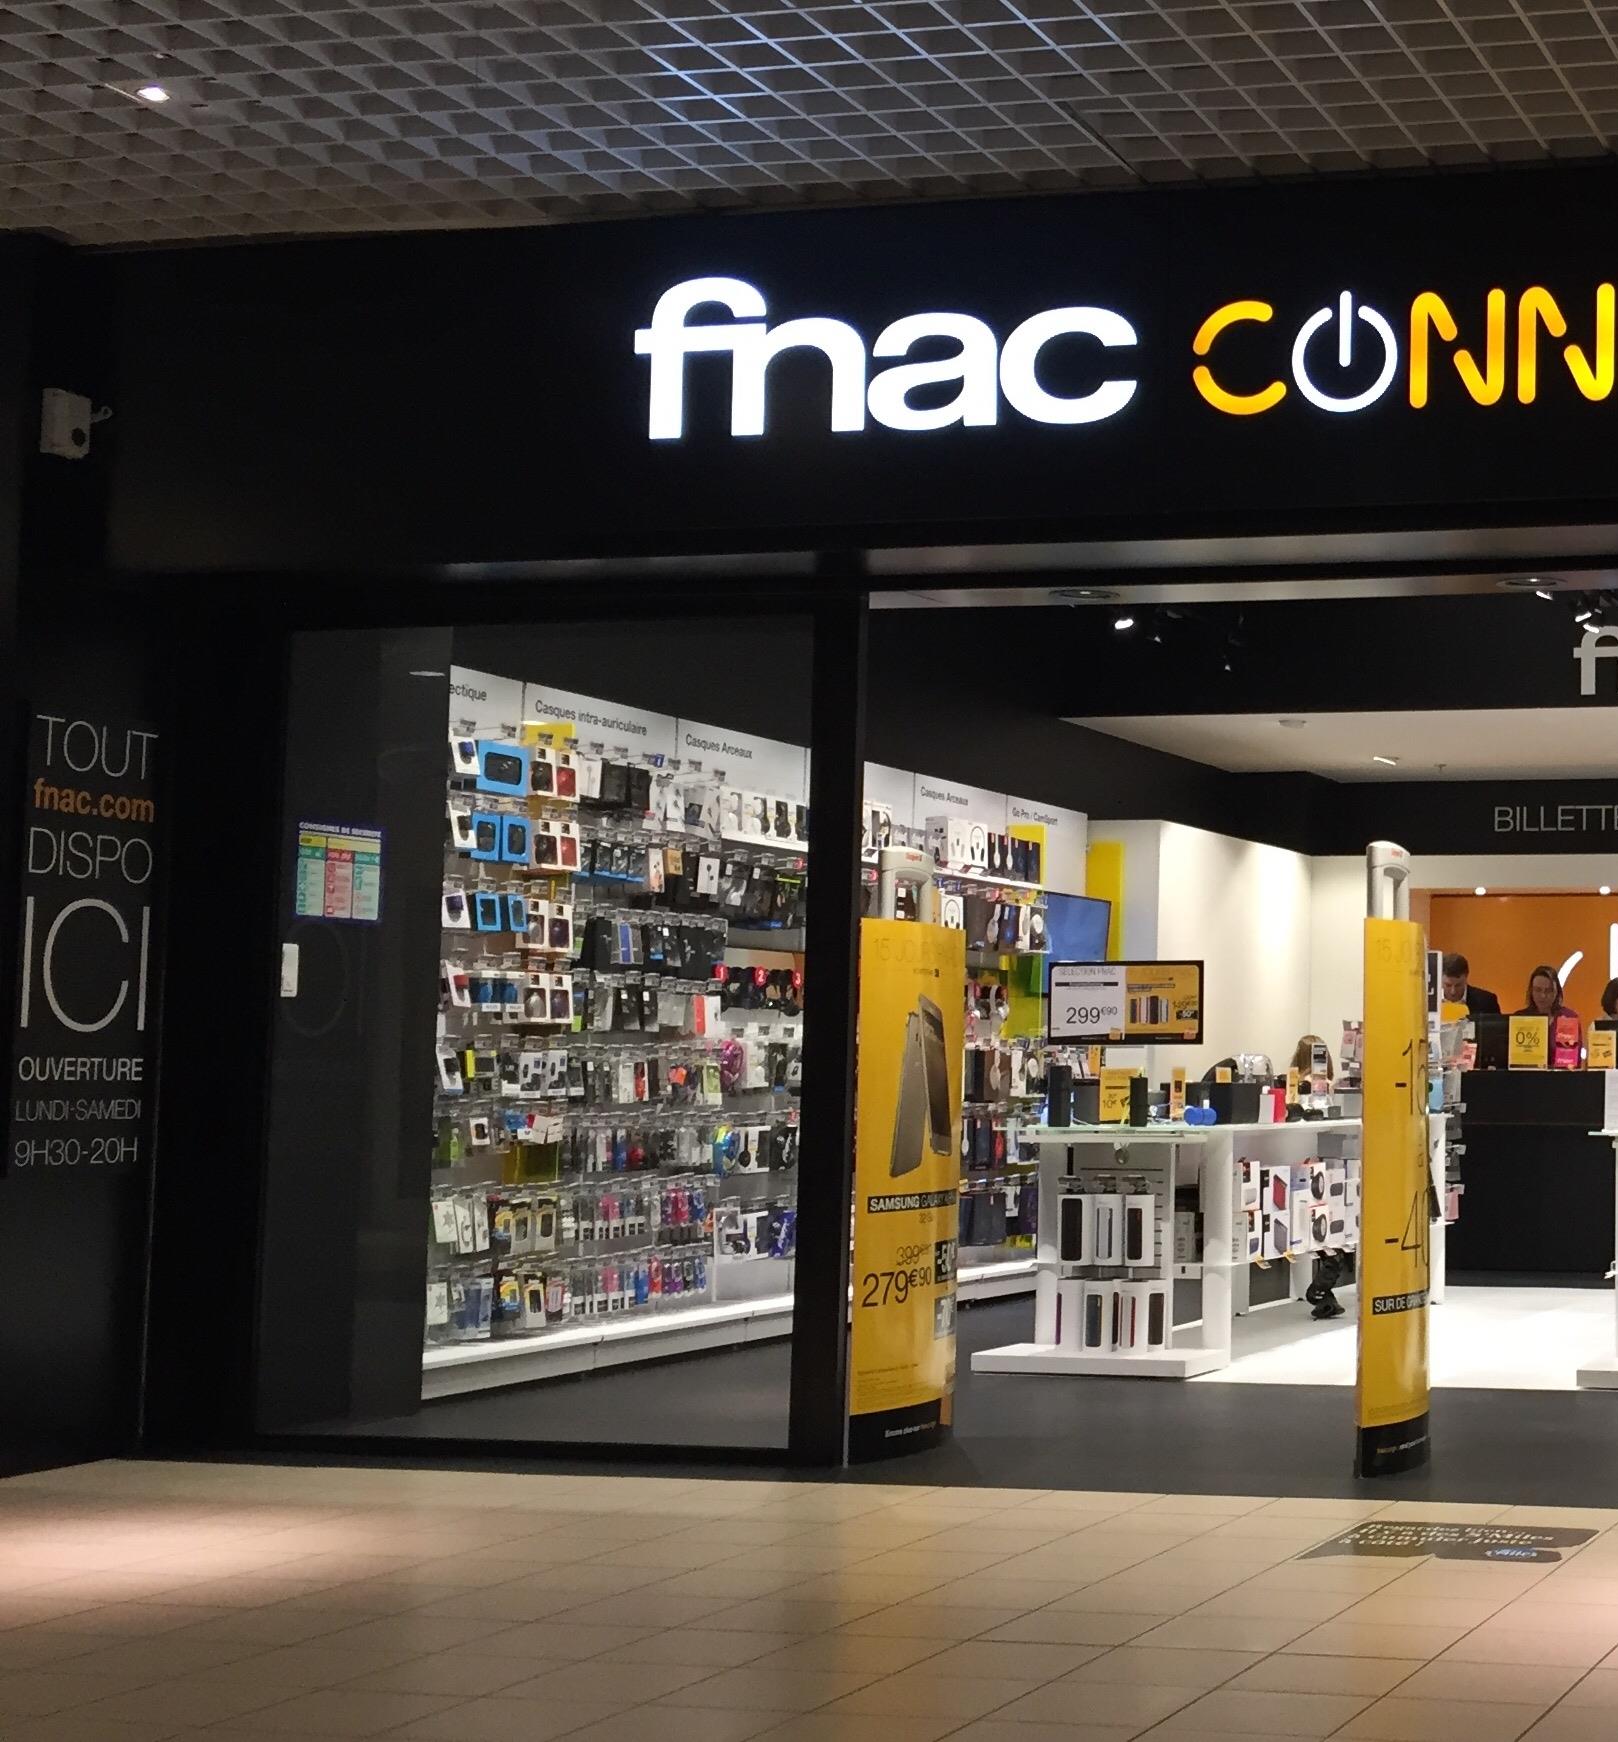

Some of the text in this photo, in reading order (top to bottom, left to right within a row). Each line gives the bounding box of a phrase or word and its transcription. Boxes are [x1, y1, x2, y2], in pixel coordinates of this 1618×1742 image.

[634, 277, 1138, 439] fnac
[535, 699, 648, 737] Casques intra-auriculaire
[36, 714, 159, 780] TOUT
[685, 733, 753, 760] Casques Arceaux
[33, 777, 155, 823] fnac.com
[920, 786, 945, 801] Casques
[28, 826, 152, 884] DISPO
[20, 895, 150, 1033] ICI
[18, 1056, 144, 1082] OUVERTURE
[15, 1099, 141, 1122] LUNDI-SAMEDI
[14, 1136, 138, 1168] 9H30-20H
[869, 1195, 920, 1212] SAMSUNG
[862, 1266, 932, 1308] 279€90
[1375, 1298, 1395, 1313] SUR
[1395, 1296, 1406, 1310] DE
